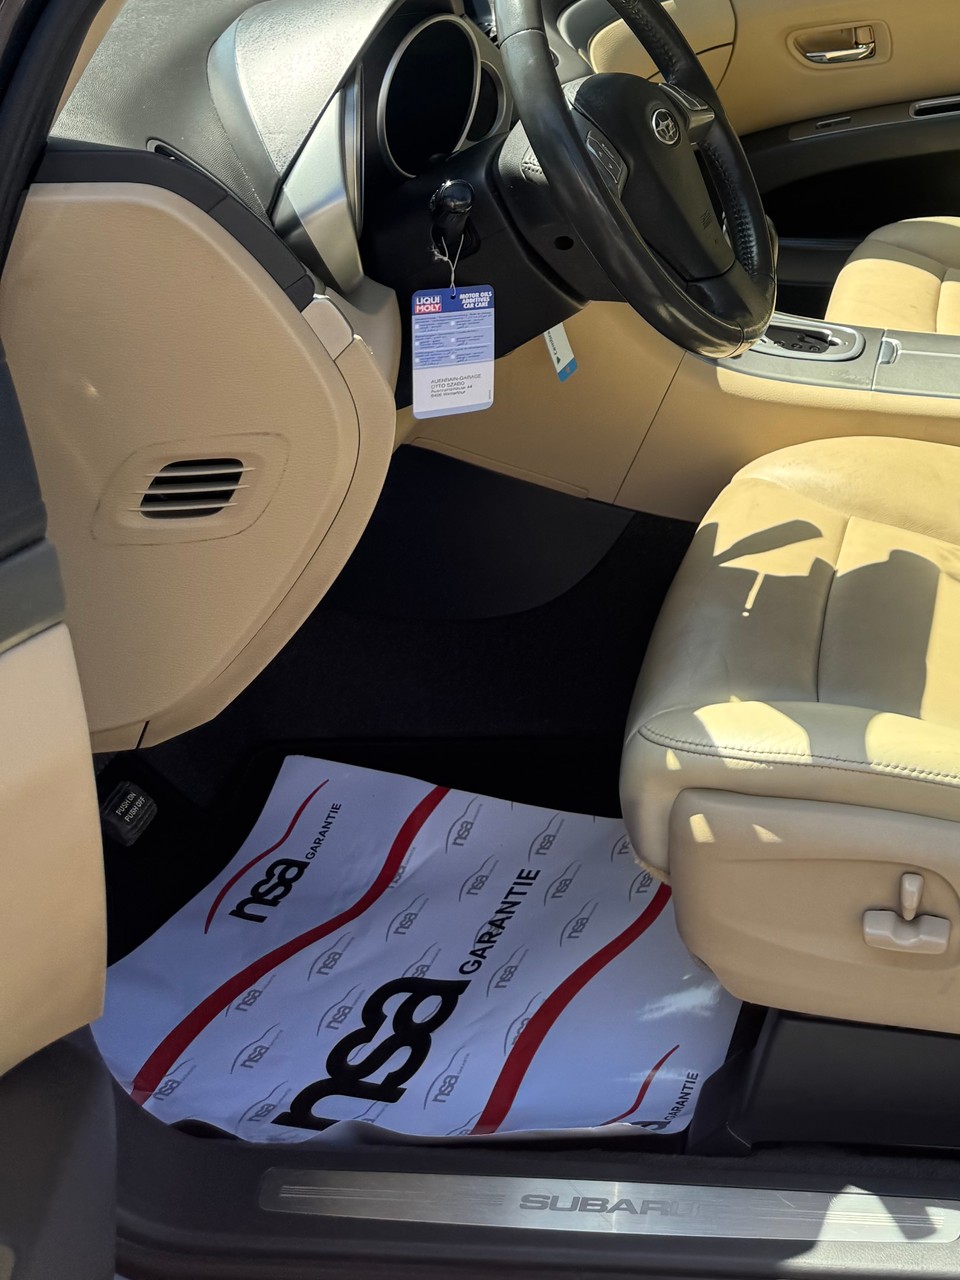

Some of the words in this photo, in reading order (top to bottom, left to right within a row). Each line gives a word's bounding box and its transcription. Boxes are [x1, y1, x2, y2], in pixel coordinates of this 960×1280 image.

[416, 296, 440, 305] LIQUI
[459, 292, 480, 300] MOTOR
[416, 304, 441, 312] MOLY
[116, 799, 131, 815] PUSH
[127, 791, 137, 801] ON
[124, 805, 139, 822] PUSH
[136, 795, 146, 807] OFF
[452, 819, 474, 847] nsa
[535, 834, 556, 855] nsa
[228, 858, 310, 923] nsa
[305, 802, 342, 860] GARANTIE
[466, 874, 489, 896] nsa
[551, 878, 573, 898] nsa
[393, 912, 418, 935] nsa
[567, 917, 589, 939] nsa
[316, 951, 343, 975] nsa
[494, 964, 518, 988] nsa
[235, 989, 263, 1012] nsa
[270, 976, 472, 1131] nsa
[458, 868, 541, 976] GARANTIE
[326, 1005, 353, 1030] nsa
[240, 1045, 269, 1068] nsa
[153, 1079, 181, 1101] nsa
[432, 1074, 459, 1103] nsa
[664, 1072, 699, 1121] GARANTIE
